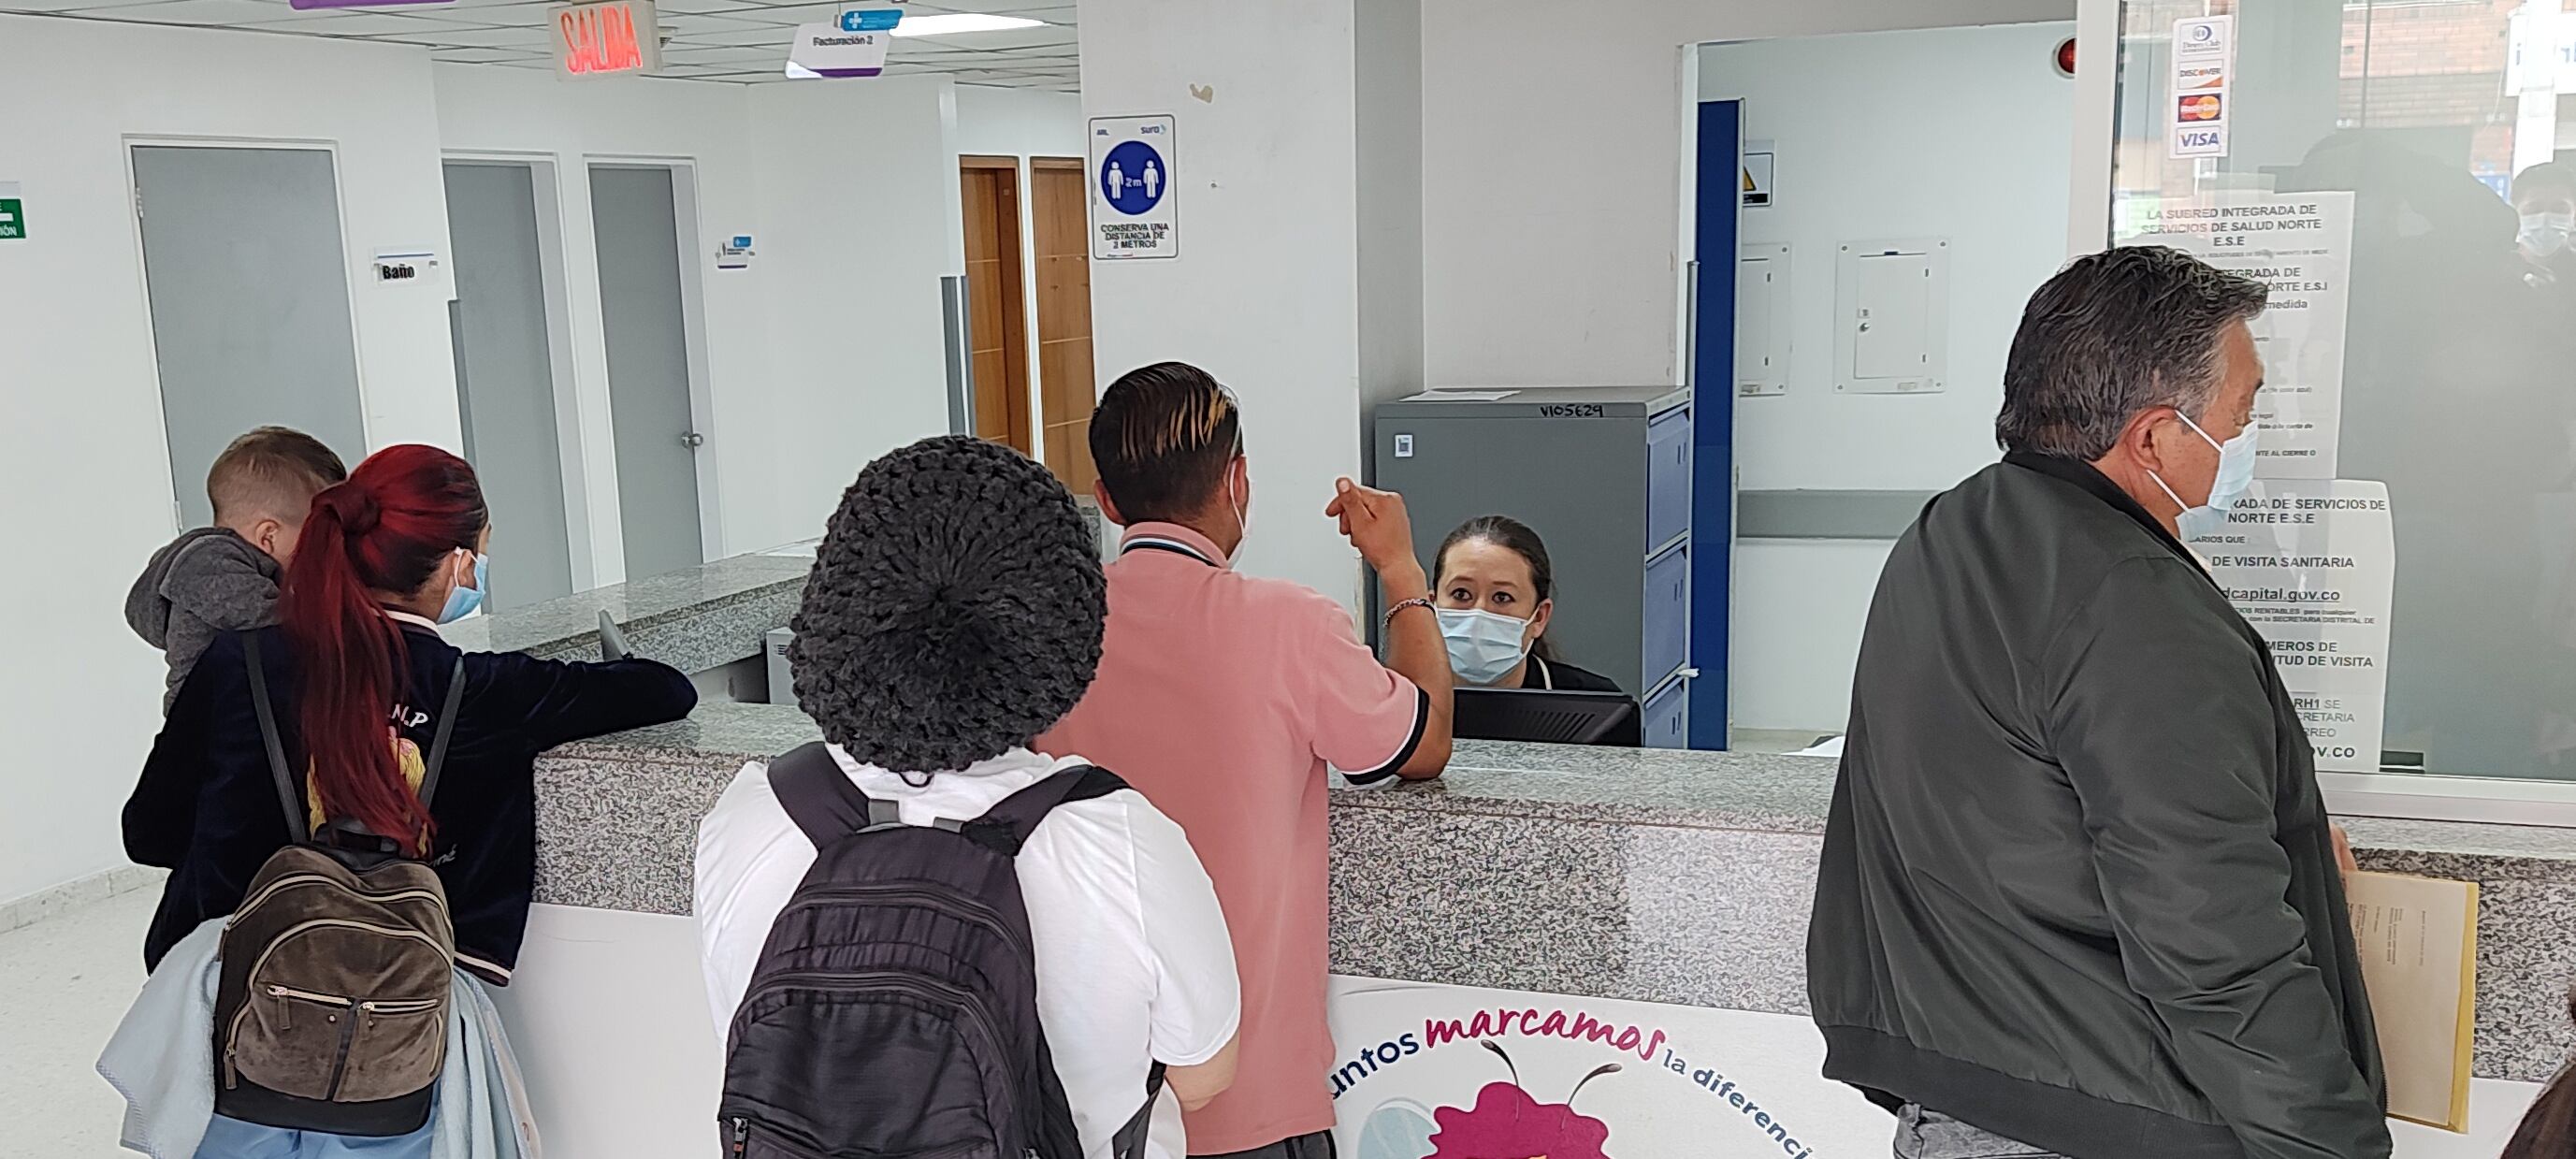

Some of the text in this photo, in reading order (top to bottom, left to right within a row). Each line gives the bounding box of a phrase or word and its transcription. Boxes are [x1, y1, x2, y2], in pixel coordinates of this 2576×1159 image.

[561, 5, 643, 75] SALIDA
[813, 35, 874, 46] Facturación 2
[2180, 132, 2220, 147] VISA
[2147, 204, 2318, 220] LA SUBRED INTEGRADA DE
[1101, 223, 1169, 233] CONSERVA UNA
[2141, 219, 2322, 234] SERVICIOS DE SALUD NORTE
[1105, 231, 1165, 241] DISTANCIA DE
[1122, 240, 1157, 249] METROS
[2213, 237, 2245, 247] E.S.E
[383, 263, 415, 280] Baño
[2284, 268, 2301, 277] DE
[2272, 499, 2291, 509] DE
[2295, 499, 2366, 510] SERVICIOS
[2370, 500, 2385, 511] DE
[2228, 513, 2315, 524] NORTE E.S.E
[2211, 557, 2354, 568] DE VISITA SANITARIA
[2318, 642, 2337, 652] DE
[2308, 656, 2326, 666] DE
[2330, 657, 2373, 667] VISITA
[2323, 700, 2341, 709] SE
[1425, 1008, 1666, 1061] marcamos
[1663, 1049, 1686, 1075] la
